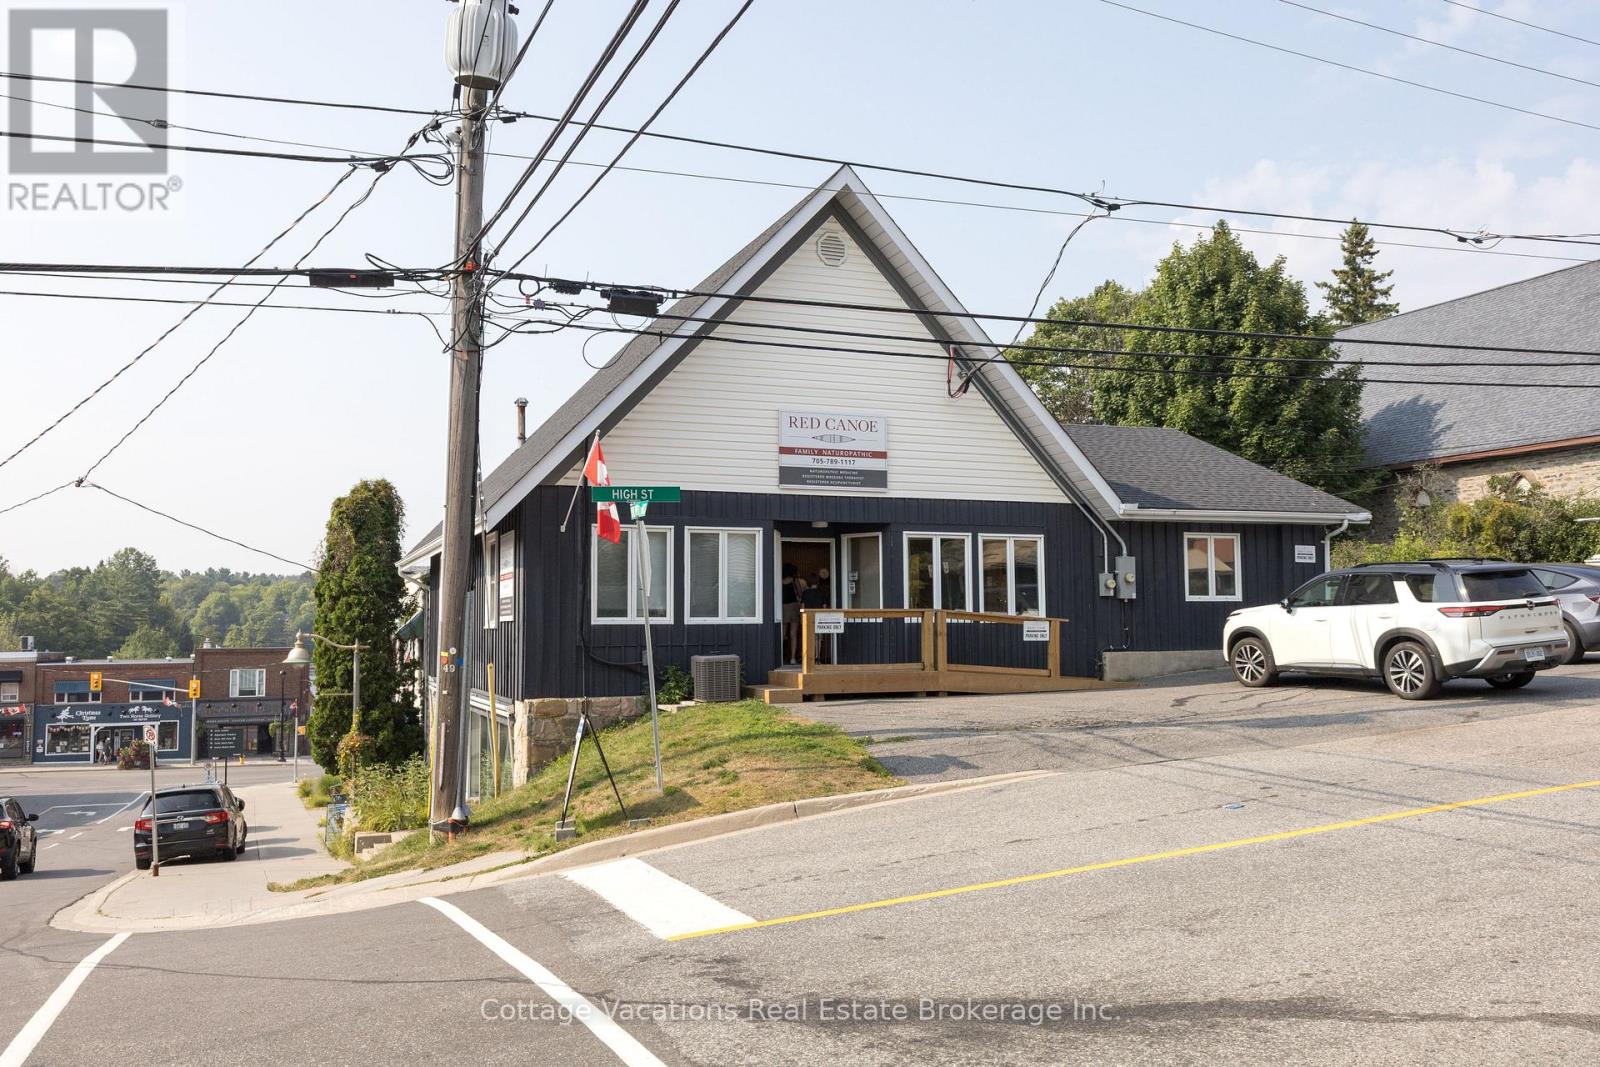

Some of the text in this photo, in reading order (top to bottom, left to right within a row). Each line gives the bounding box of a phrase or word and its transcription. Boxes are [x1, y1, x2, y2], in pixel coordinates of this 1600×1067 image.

[789, 415, 878, 433] RED CANOE
[795, 448, 873, 458] FAMILY NATUROPATHIC
[812, 457, 856, 465] 705-789-1117
[612, 489, 654, 499] HIGH ST
[443, 664, 456, 673] 49
